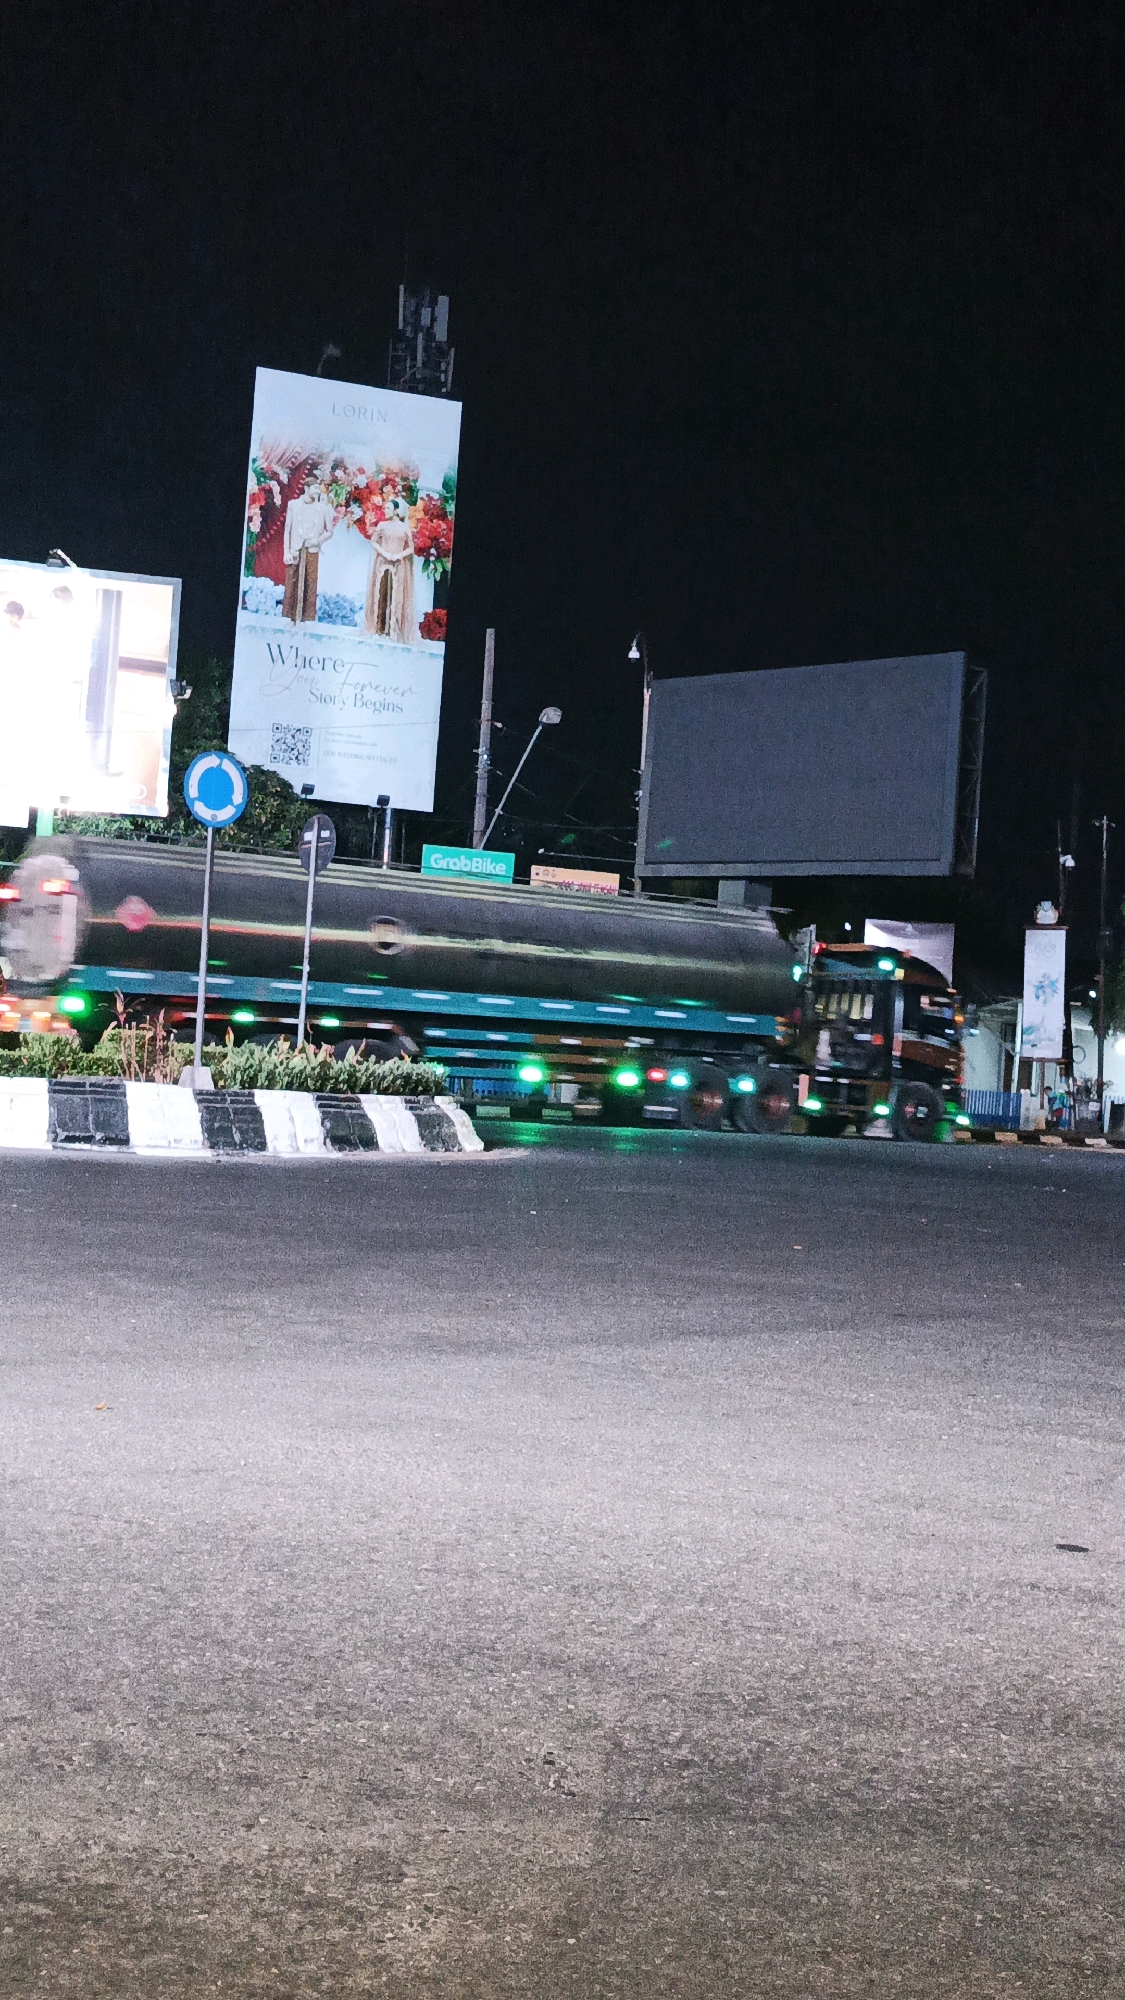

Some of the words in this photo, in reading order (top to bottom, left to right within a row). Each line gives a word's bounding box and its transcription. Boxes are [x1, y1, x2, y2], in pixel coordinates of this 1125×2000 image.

[332, 402, 388, 423] LORIN
[266, 643, 345, 674] Where
[335, 662, 416, 698] Forever
[308, 687, 349, 711] Story
[353, 692, 404, 715] Begins
[430, 853, 507, 875] GrabBike
